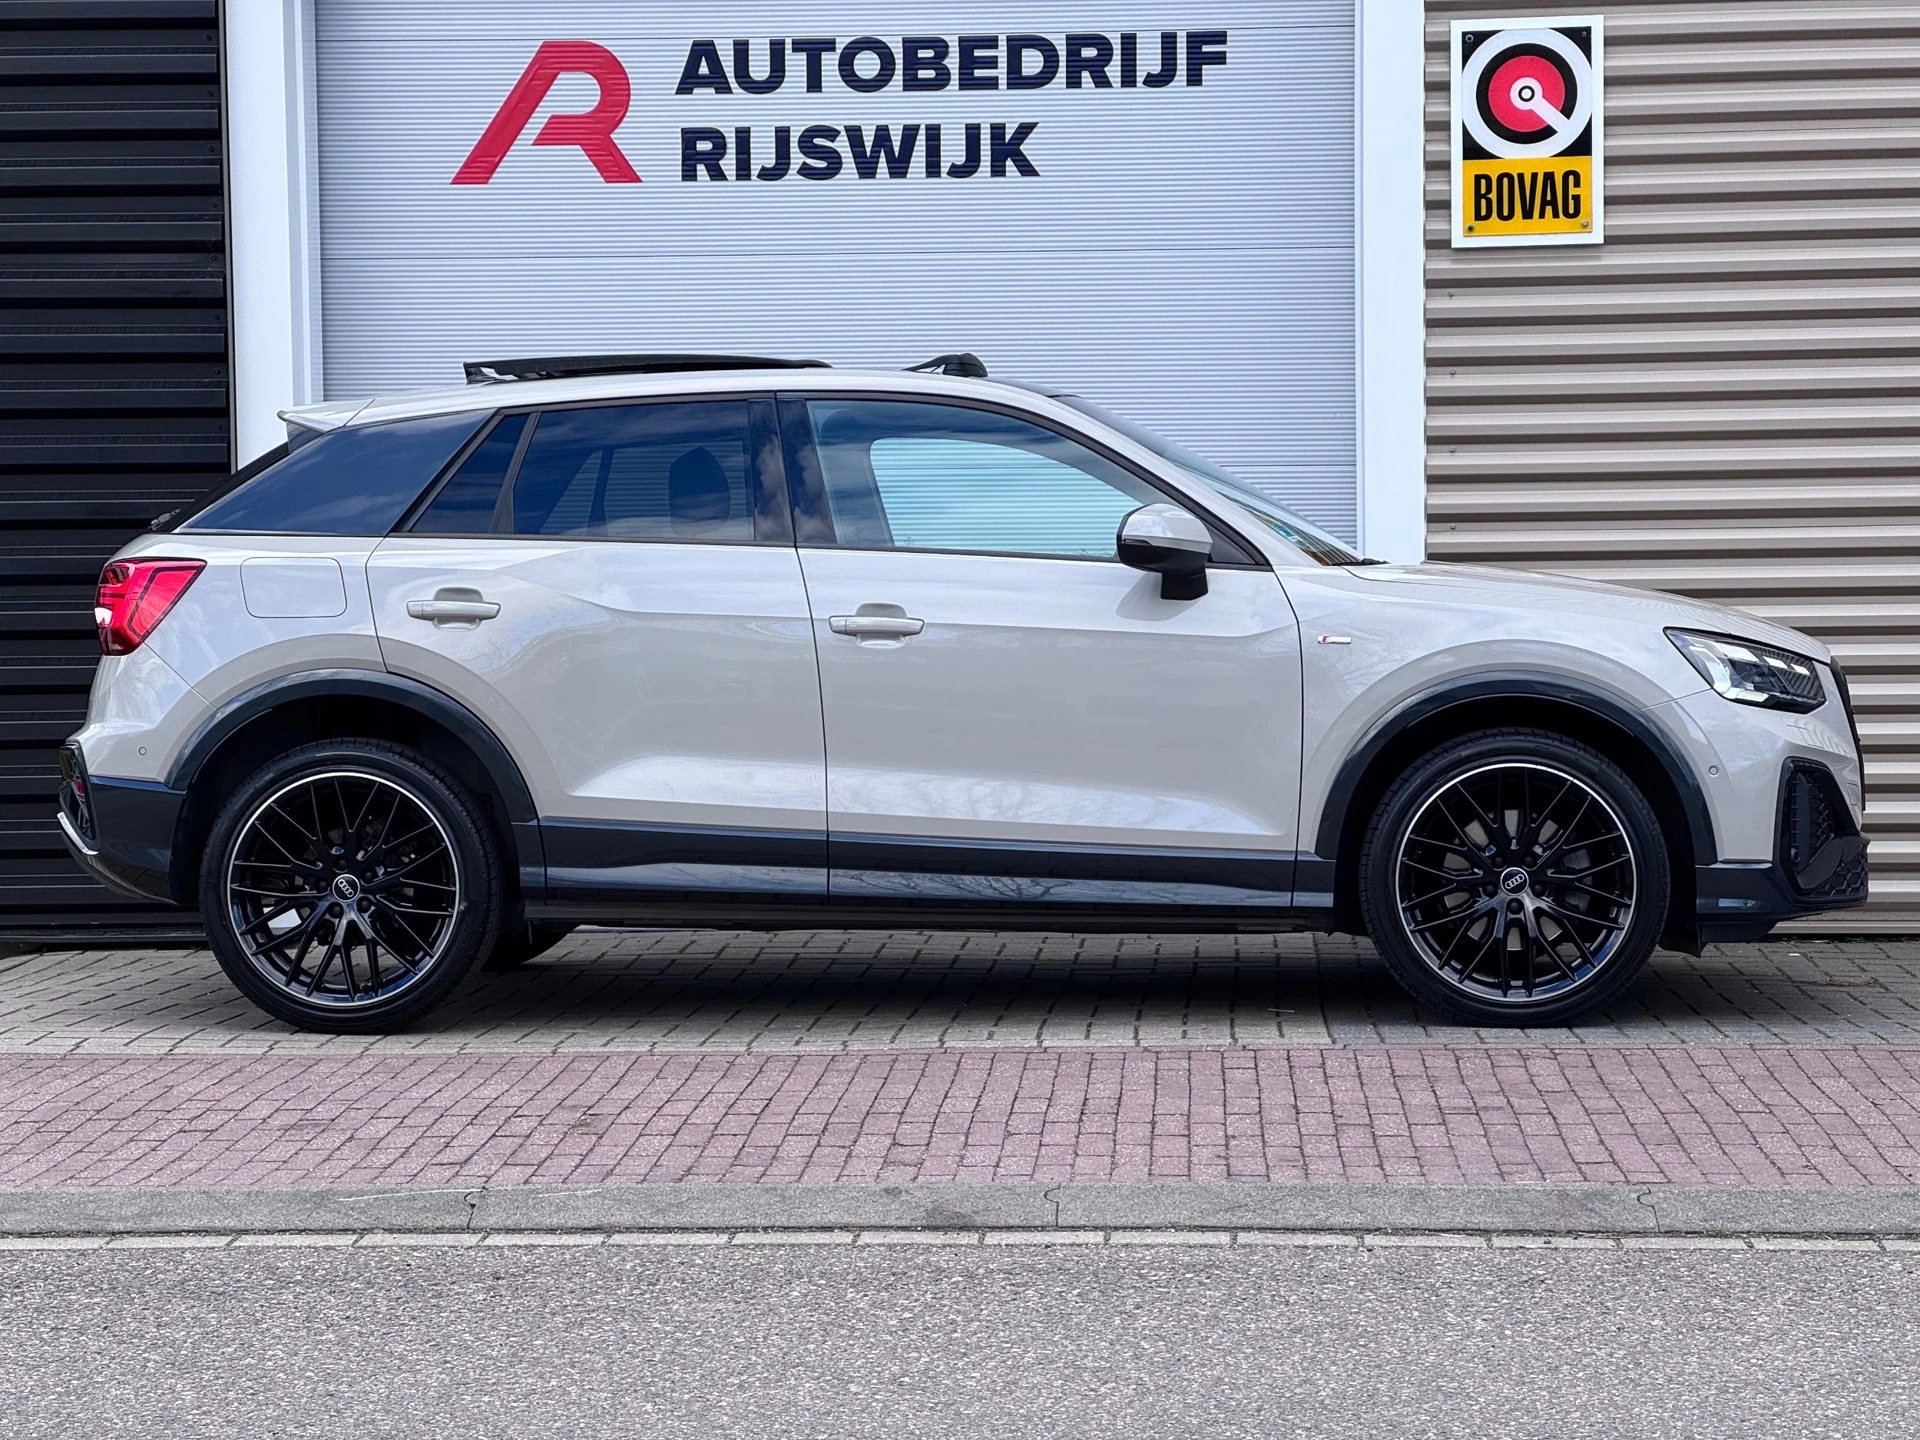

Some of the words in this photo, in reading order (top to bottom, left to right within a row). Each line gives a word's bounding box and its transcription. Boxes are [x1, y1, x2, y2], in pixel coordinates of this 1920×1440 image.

[674, 30, 1228, 96] AUTOBEDRIJF
[680, 121, 1041, 182] RIJSWIJK
[1473, 169, 1582, 222] BOVAG
